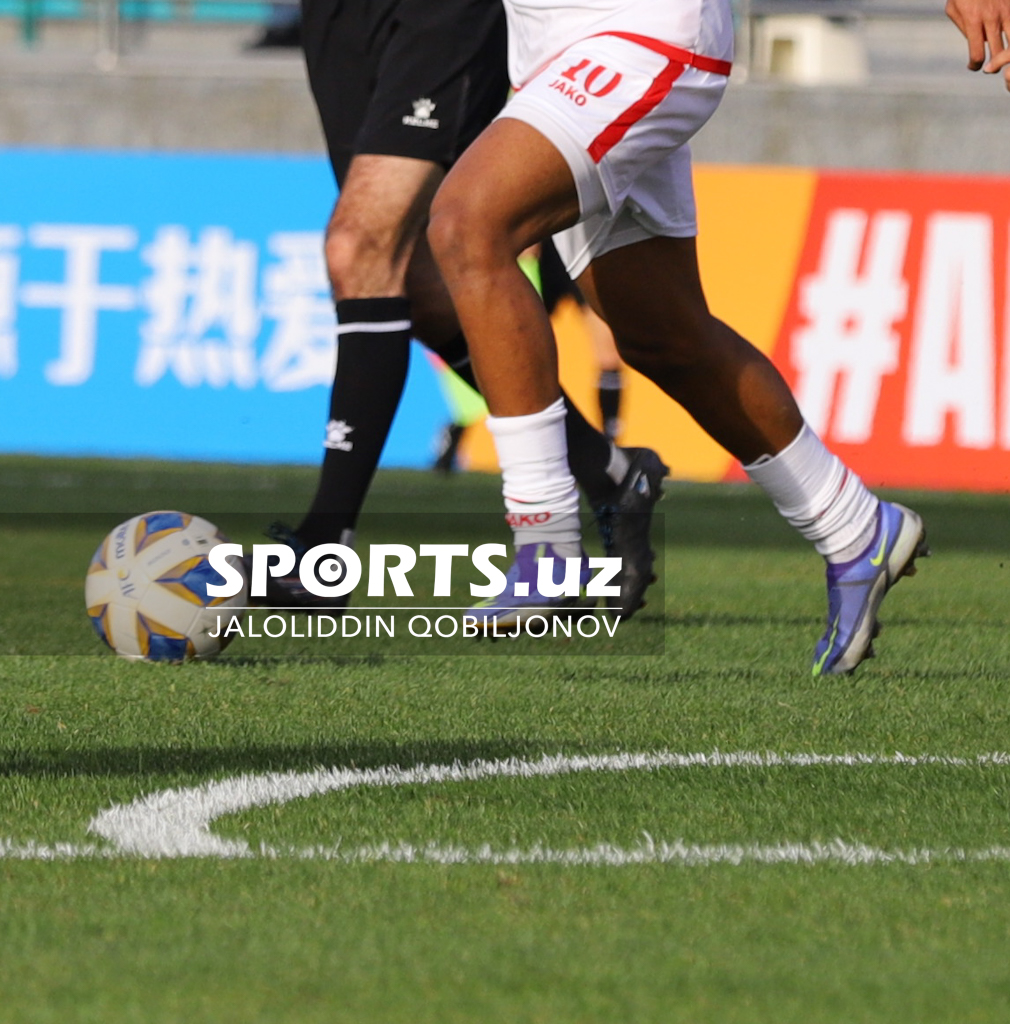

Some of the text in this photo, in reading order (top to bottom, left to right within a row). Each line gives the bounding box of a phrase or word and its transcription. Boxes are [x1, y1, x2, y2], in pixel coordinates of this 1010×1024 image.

[548, 79, 587, 106] JAKO
[561, 58, 622, 97] 10
[0, 222, 337, 391] 于热爱
